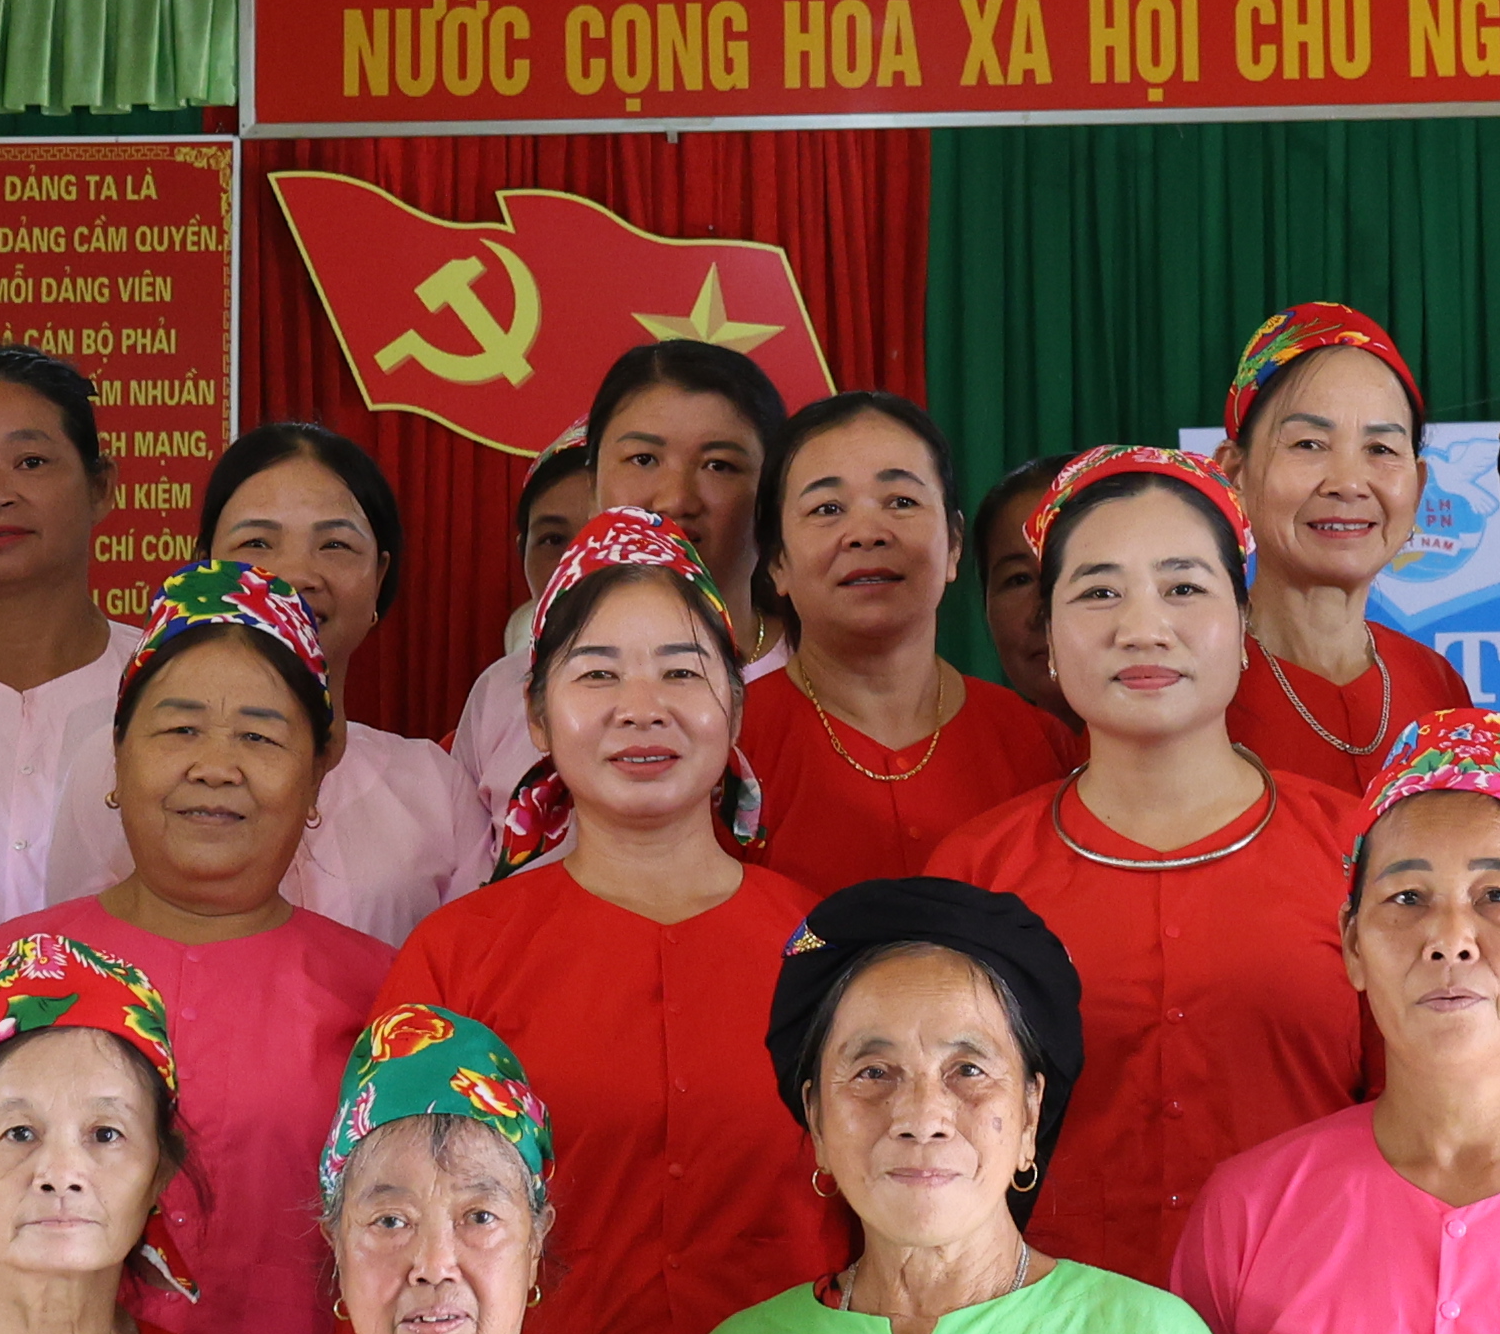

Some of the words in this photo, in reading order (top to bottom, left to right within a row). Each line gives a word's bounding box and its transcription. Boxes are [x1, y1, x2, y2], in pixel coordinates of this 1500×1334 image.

[85, 174, 118, 201] TA
[126, 167, 158, 201] LÀ
[73, 215, 128, 253] CẦM
[134, 214, 223, 253] QUYỀN.
[117, 269, 172, 303] VIÊN
[81, 321, 114, 363] BỘ
[121, 318, 177, 354] PHẢI
[129, 368, 216, 406] NHUẦN
[134, 430, 214, 466] MẠNG,
[134, 476, 192, 517] KIỆM
[94, 528, 135, 562] CHÍ
[140, 525, 200, 563] CÔN
[1421, 537, 1454, 551] NAM
